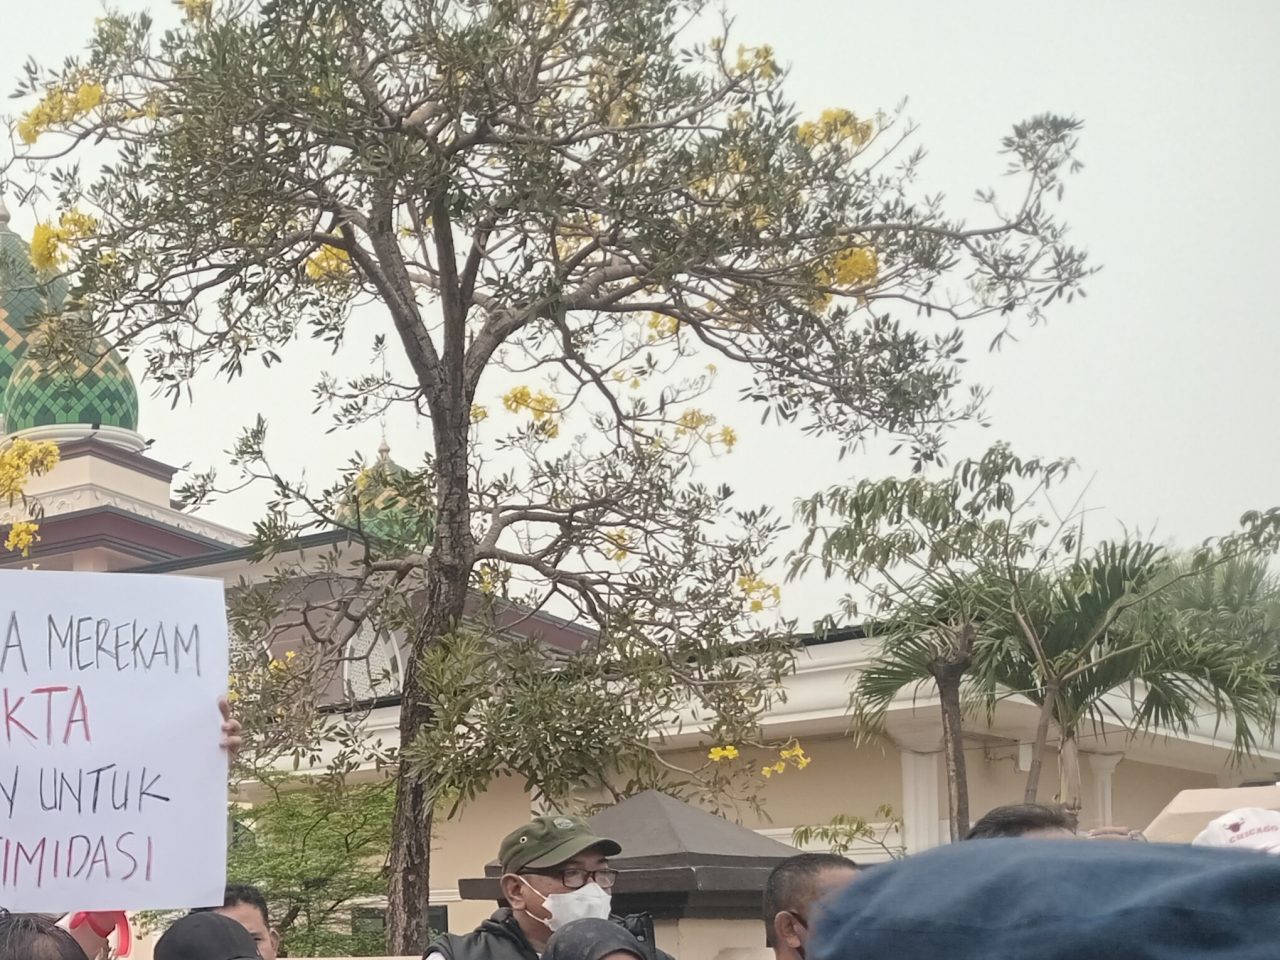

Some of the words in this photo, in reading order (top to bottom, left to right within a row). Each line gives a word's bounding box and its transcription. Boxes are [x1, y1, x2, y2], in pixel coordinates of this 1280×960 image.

[47, 613, 202, 677] MEREKAM
[39, 763, 171, 815] UNTUK
[1229, 825, 1279, 843] CHICAGO
